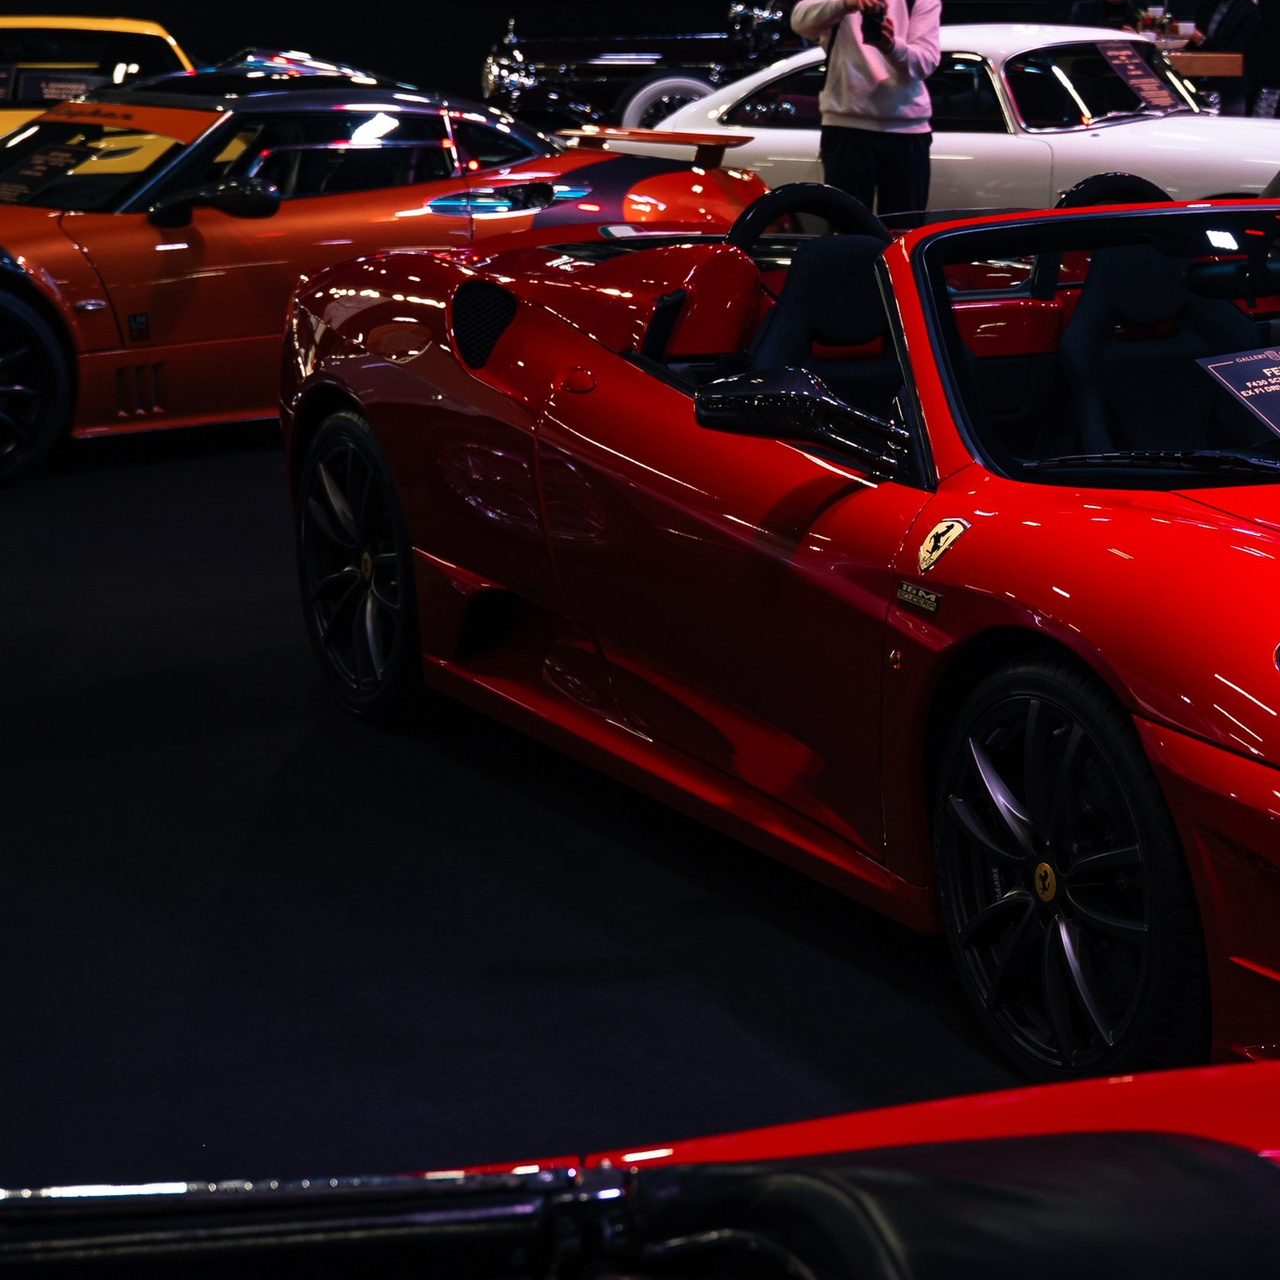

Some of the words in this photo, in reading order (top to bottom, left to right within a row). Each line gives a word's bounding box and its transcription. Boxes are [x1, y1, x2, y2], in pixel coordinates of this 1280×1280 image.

[1235, 352, 1267, 363] GALLERY
[1246, 379, 1268, 389] F430
[1241, 390, 1253, 398] EX
[1254, 388, 1264, 396] F1
